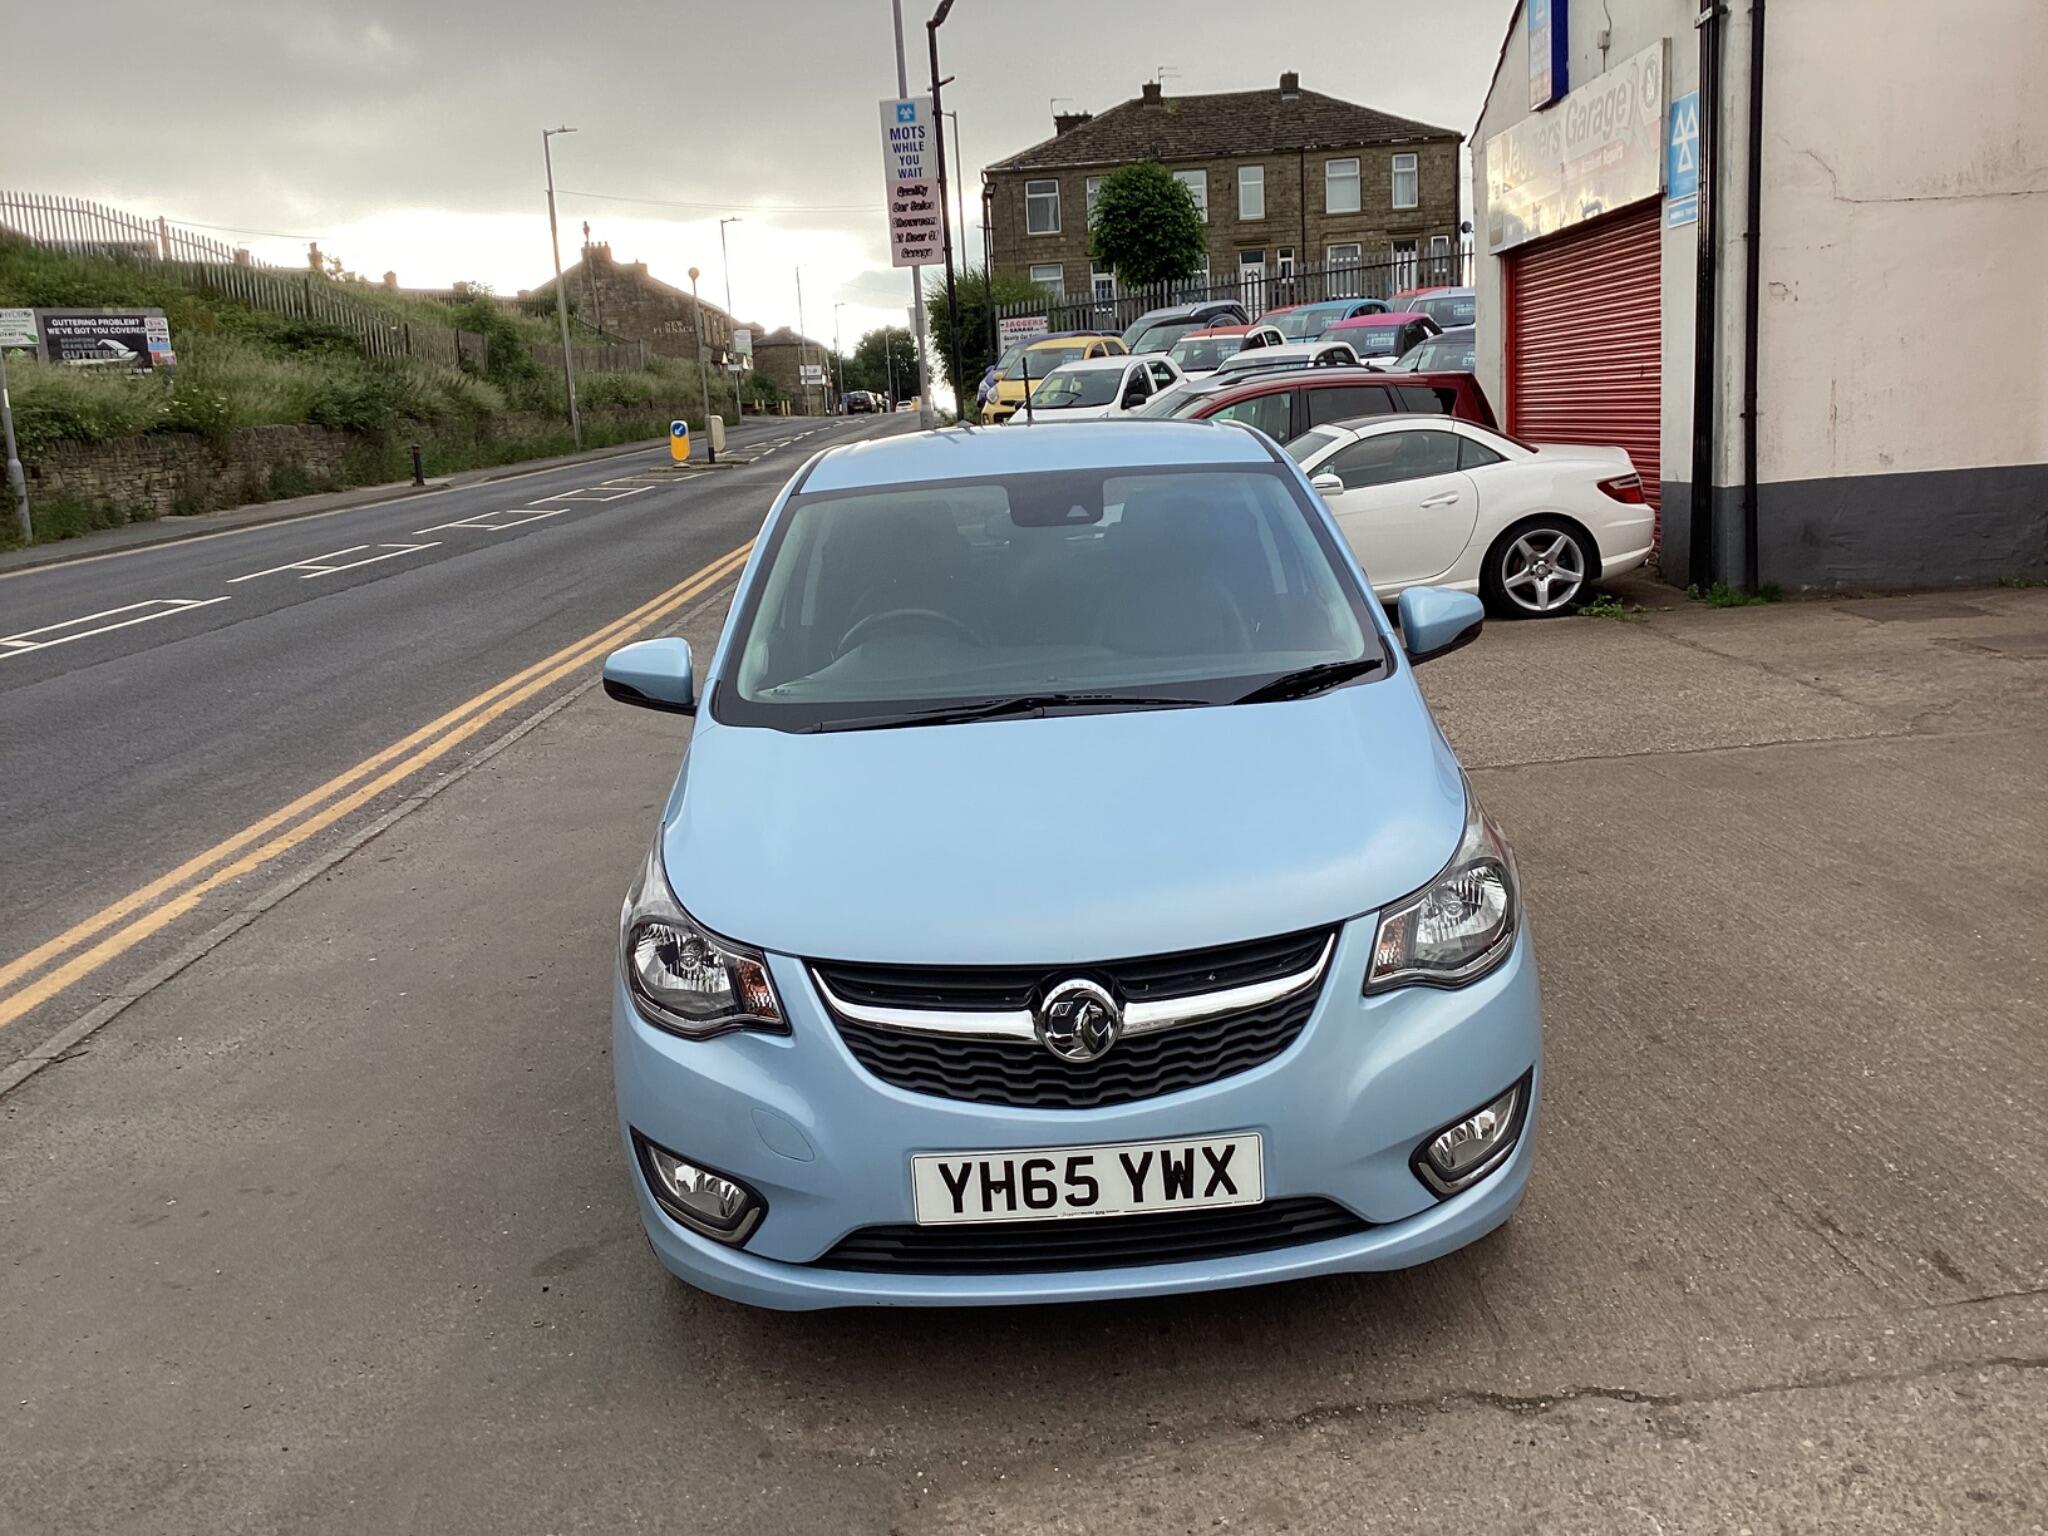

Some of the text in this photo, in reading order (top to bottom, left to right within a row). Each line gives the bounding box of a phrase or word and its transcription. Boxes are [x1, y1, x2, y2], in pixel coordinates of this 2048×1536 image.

[1565, 82, 1626, 148] Garage
[889, 125, 926, 141] MOTS
[892, 141, 925, 154] WHILE
[899, 154, 920, 166] YOU
[897, 167, 924, 179] WAIT
[896, 185, 929, 198] Quality
[892, 201, 935, 213] Car Sales
[892, 216, 938, 229] Showroom
[905, 232, 927, 243] Rear
[901, 247, 933, 259] Garage
[51, 317, 140, 326] GUTTERING PROBLEM?
[1005, 319, 1044, 328] JAGGERS
[47, 327, 74, 335] WE'VE
[74, 327, 90, 335] GOT
[92, 326, 109, 334] YOU
[62, 350, 118, 360] GUTTERS
[937, 1144, 1238, 1214] YH65 YWX
